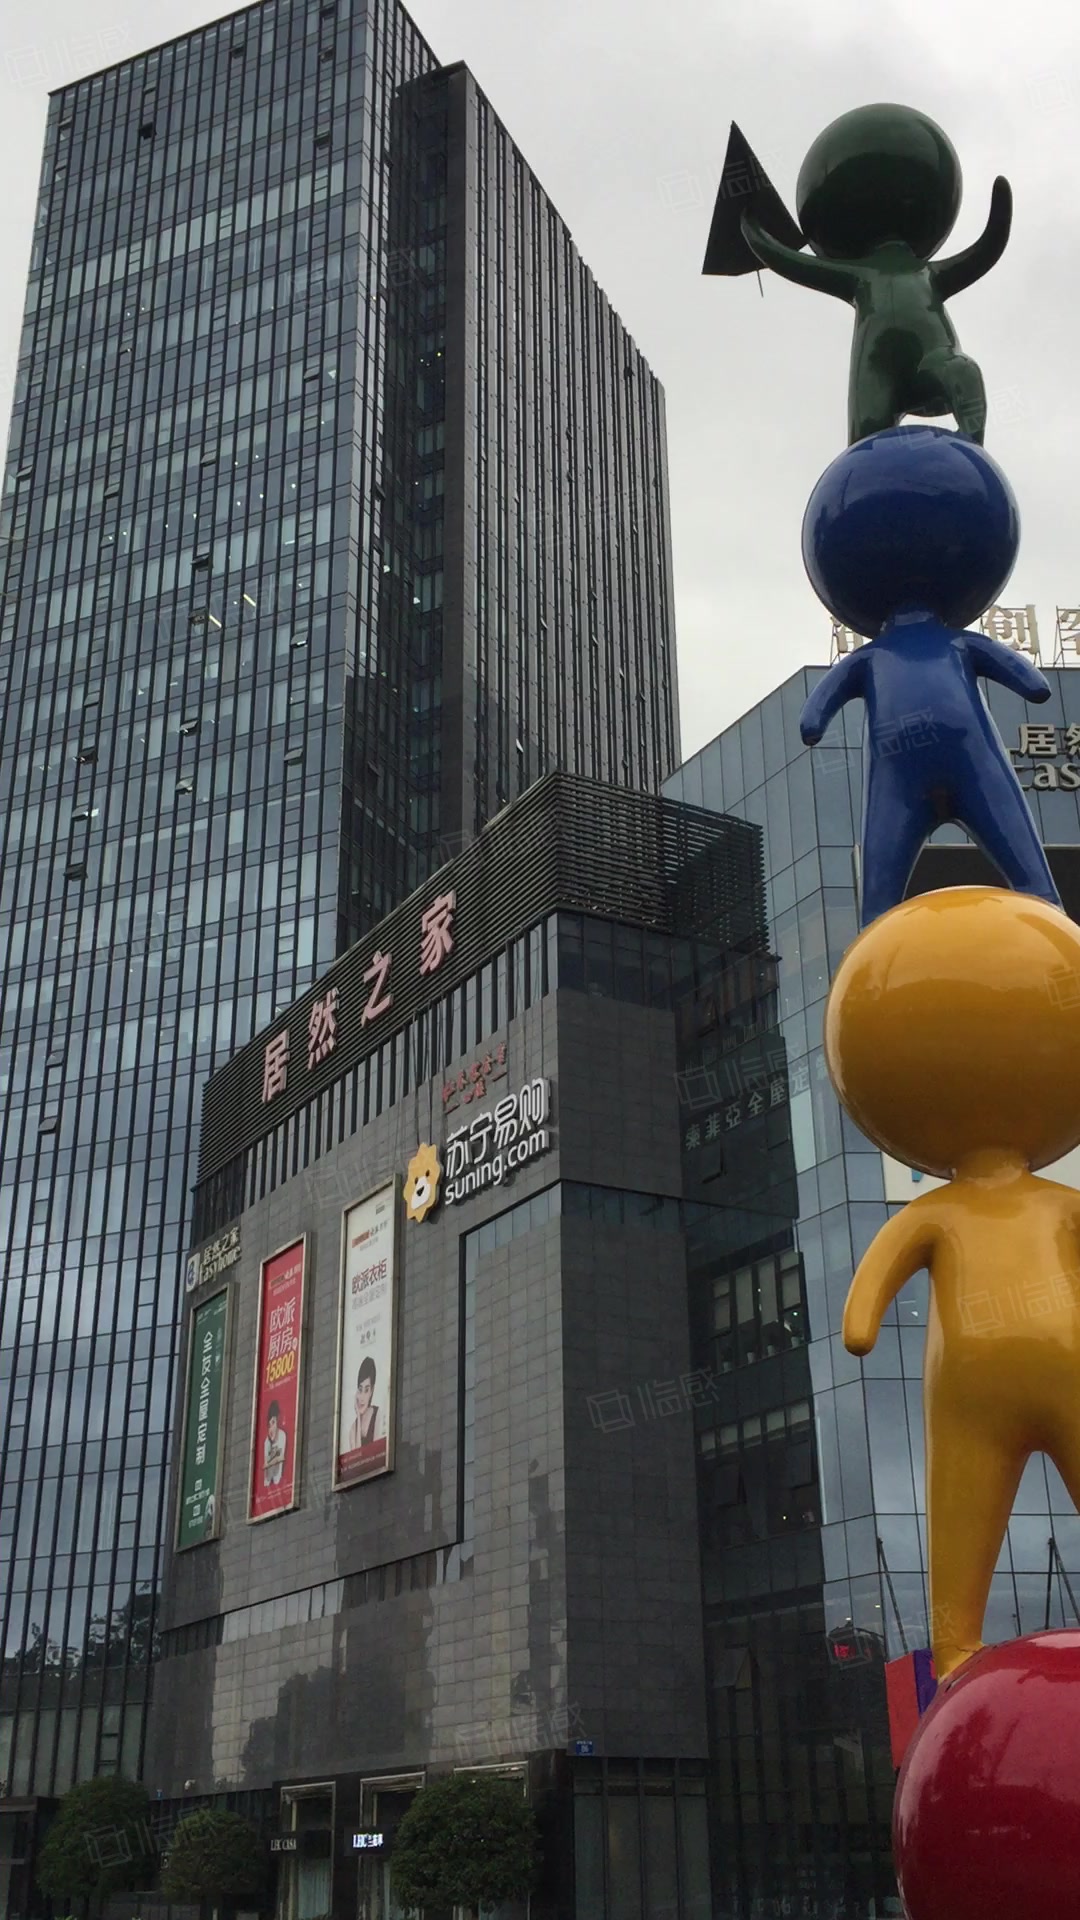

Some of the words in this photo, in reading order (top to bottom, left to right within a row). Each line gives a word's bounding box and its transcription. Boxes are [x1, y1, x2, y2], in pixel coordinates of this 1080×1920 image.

[262, 889, 458, 1104] 居然之家
[445, 1076, 550, 1179] 苏宁易购
[444, 1128, 550, 1206] suning.com
[351, 1257, 388, 1295] 欧派衣柜
[268, 1296, 296, 1334] 欧派
[267, 1327, 293, 1361] 厨房
[264, 1350, 296, 1385] 15800
